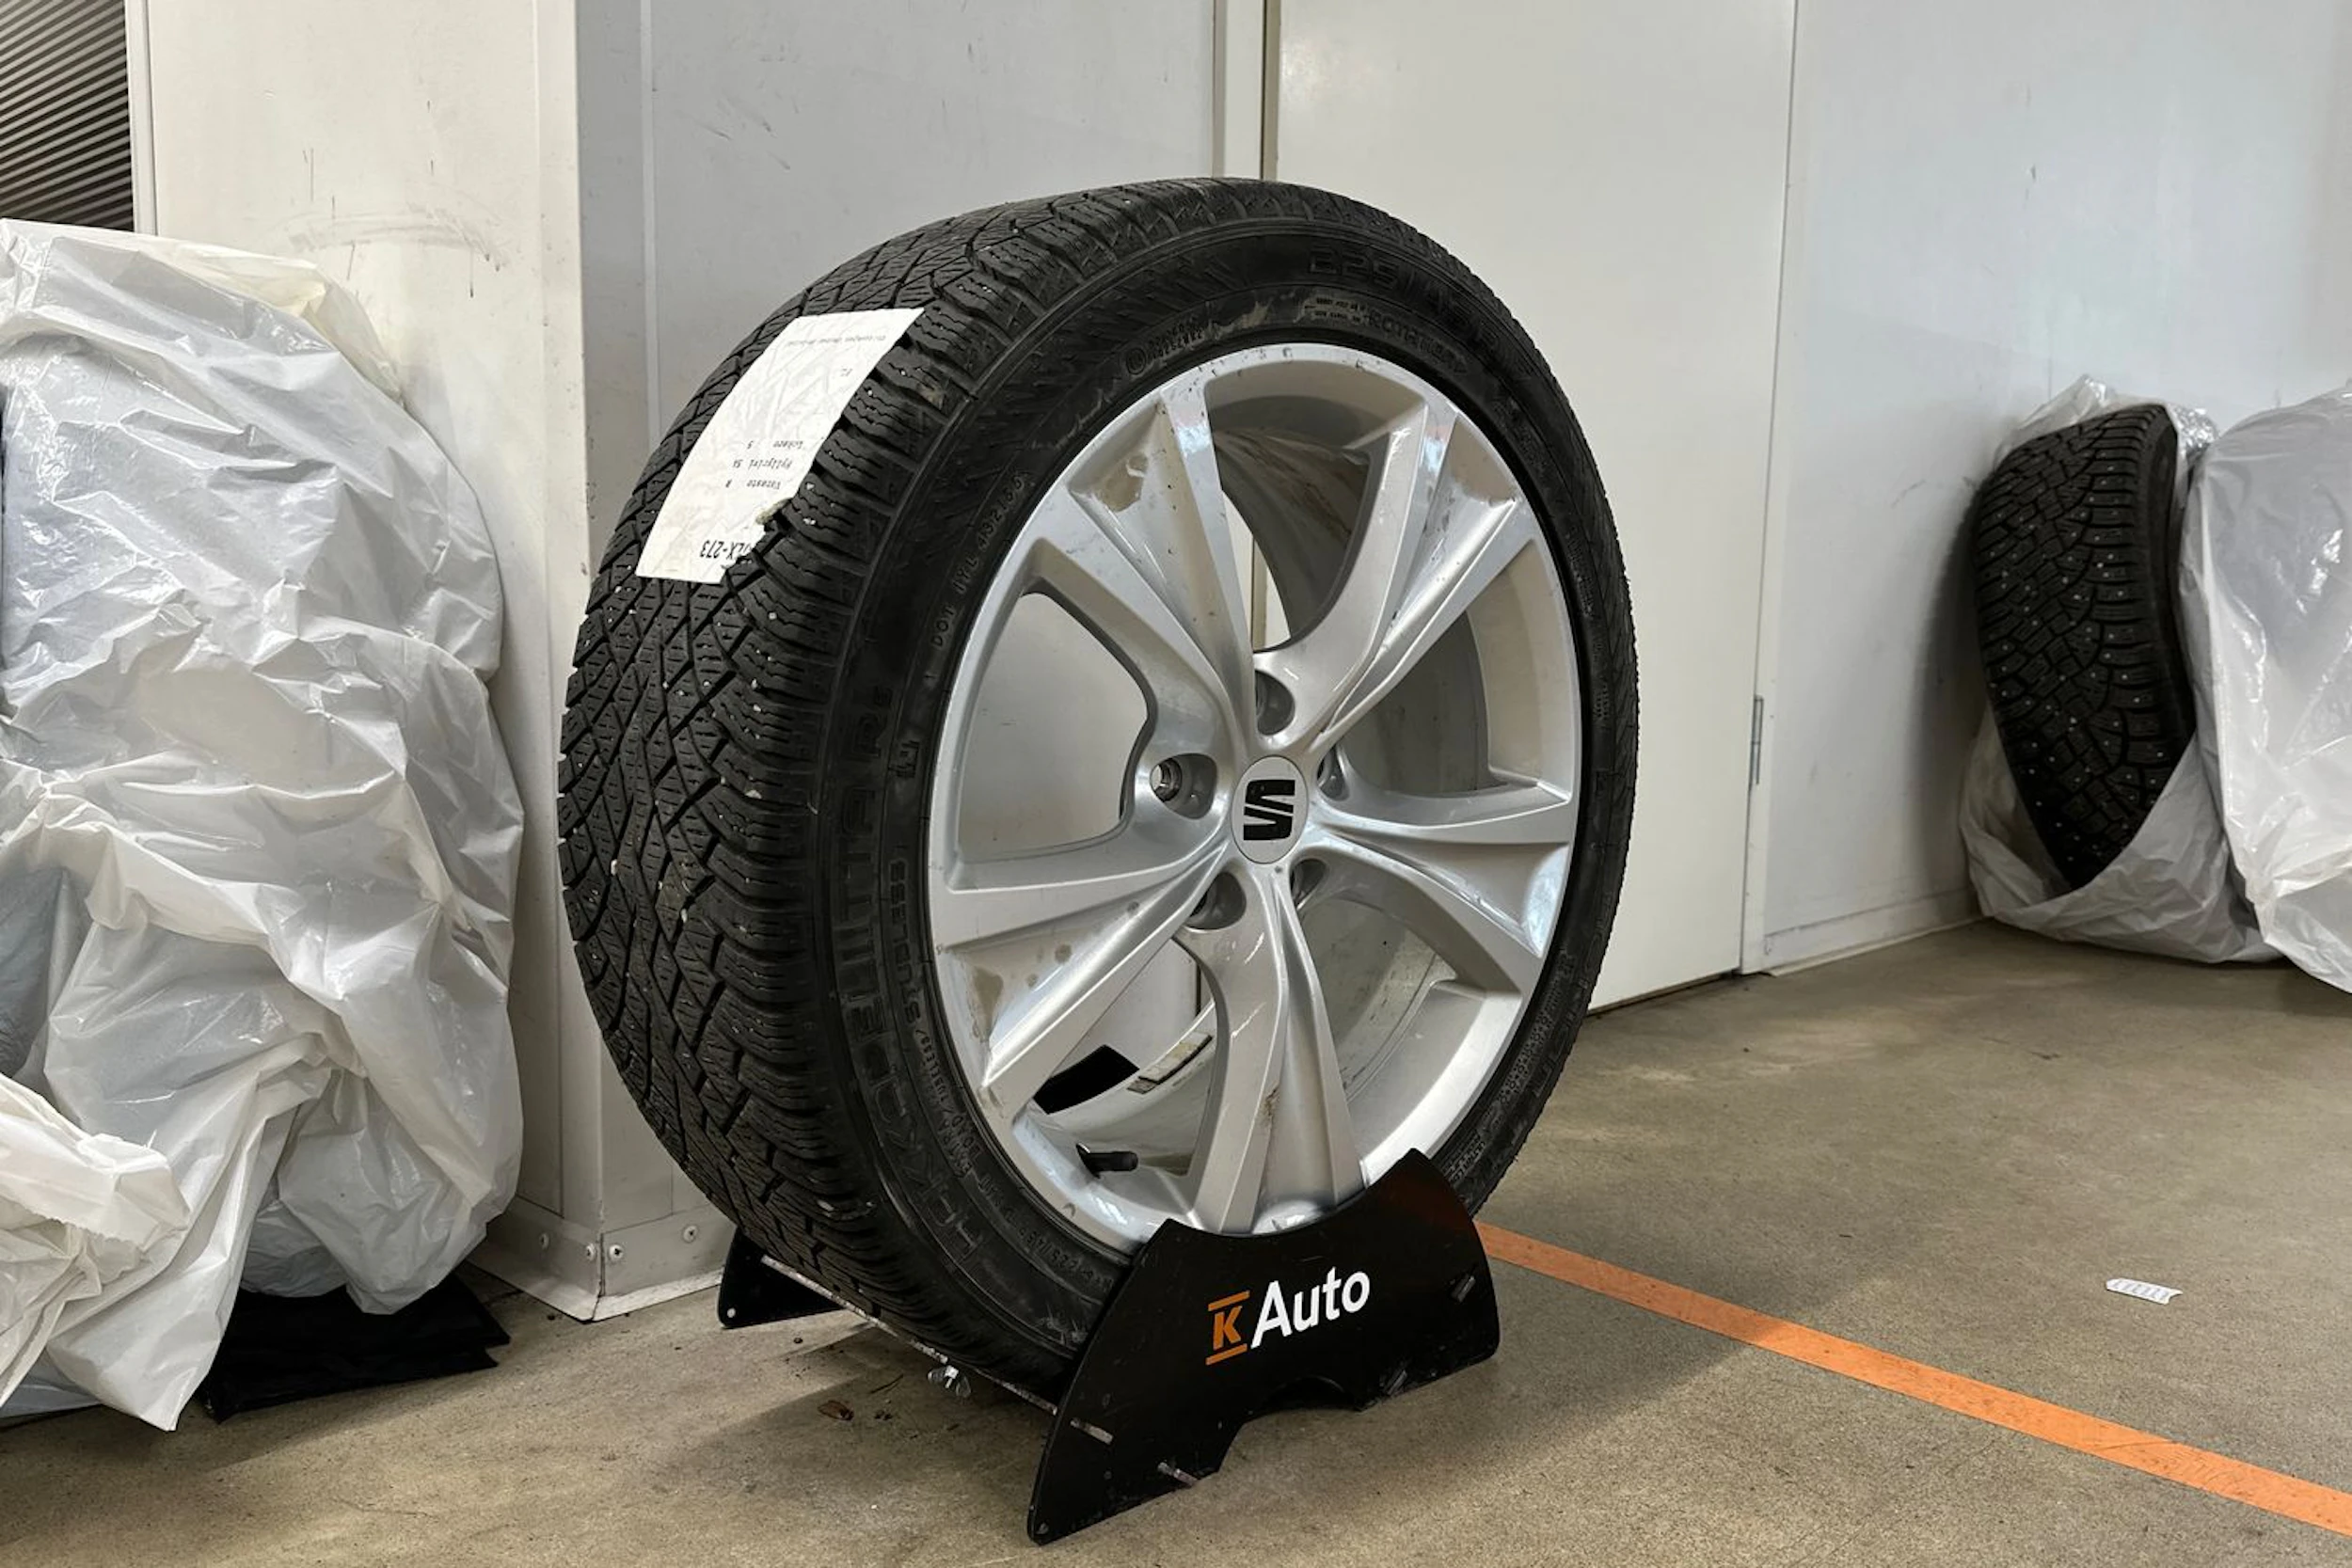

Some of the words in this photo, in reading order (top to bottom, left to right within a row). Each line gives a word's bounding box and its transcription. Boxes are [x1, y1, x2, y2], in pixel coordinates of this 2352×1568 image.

[933, 605, 956, 646] DOT
[1211, 1304, 1244, 1351] K
[1250, 1266, 1371, 1349] Auto
